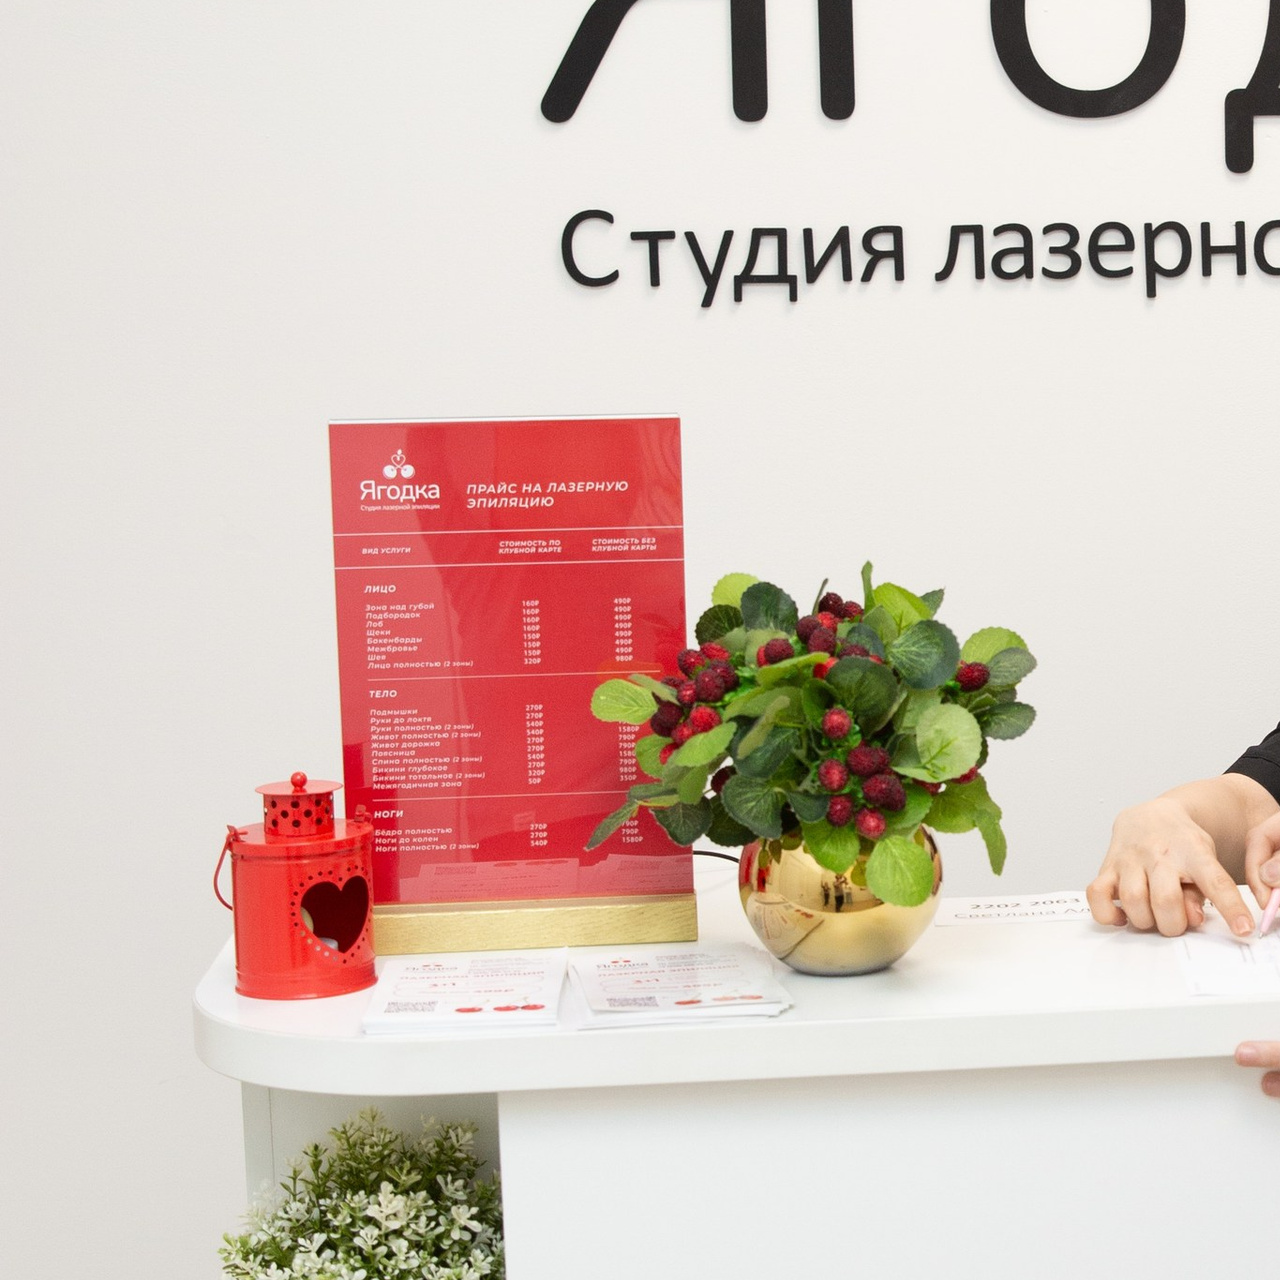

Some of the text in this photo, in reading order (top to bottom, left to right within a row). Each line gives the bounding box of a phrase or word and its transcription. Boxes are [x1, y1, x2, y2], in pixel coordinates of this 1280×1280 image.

[560, 209, 905, 308] Студия
[360, 480, 440, 502] Ягодка
[467, 481, 628, 494] ПРАЙС НА ЛАЗЕРНУЮ
[467, 497, 554, 509] ЭПИЛЯЦИЮ
[499, 546, 562, 554] КЛУБНОЙ КАРТЕ
[592, 544, 656, 552] КЛУБНОЙ КАРТЫ
[364, 585, 396, 593] ЛИЦО
[409, 602, 434, 610] губой
[366, 612, 420, 620] Подбородок
[369, 690, 398, 698] ТЕЛО
[402, 732, 449, 740] полностью
[372, 766, 405, 774] Бикини
[373, 782, 438, 790] Межягодичная
[374, 810, 404, 818] НОГИ
[375, 828, 402, 836] Бёдра
[400, 844, 447, 852] полностью
